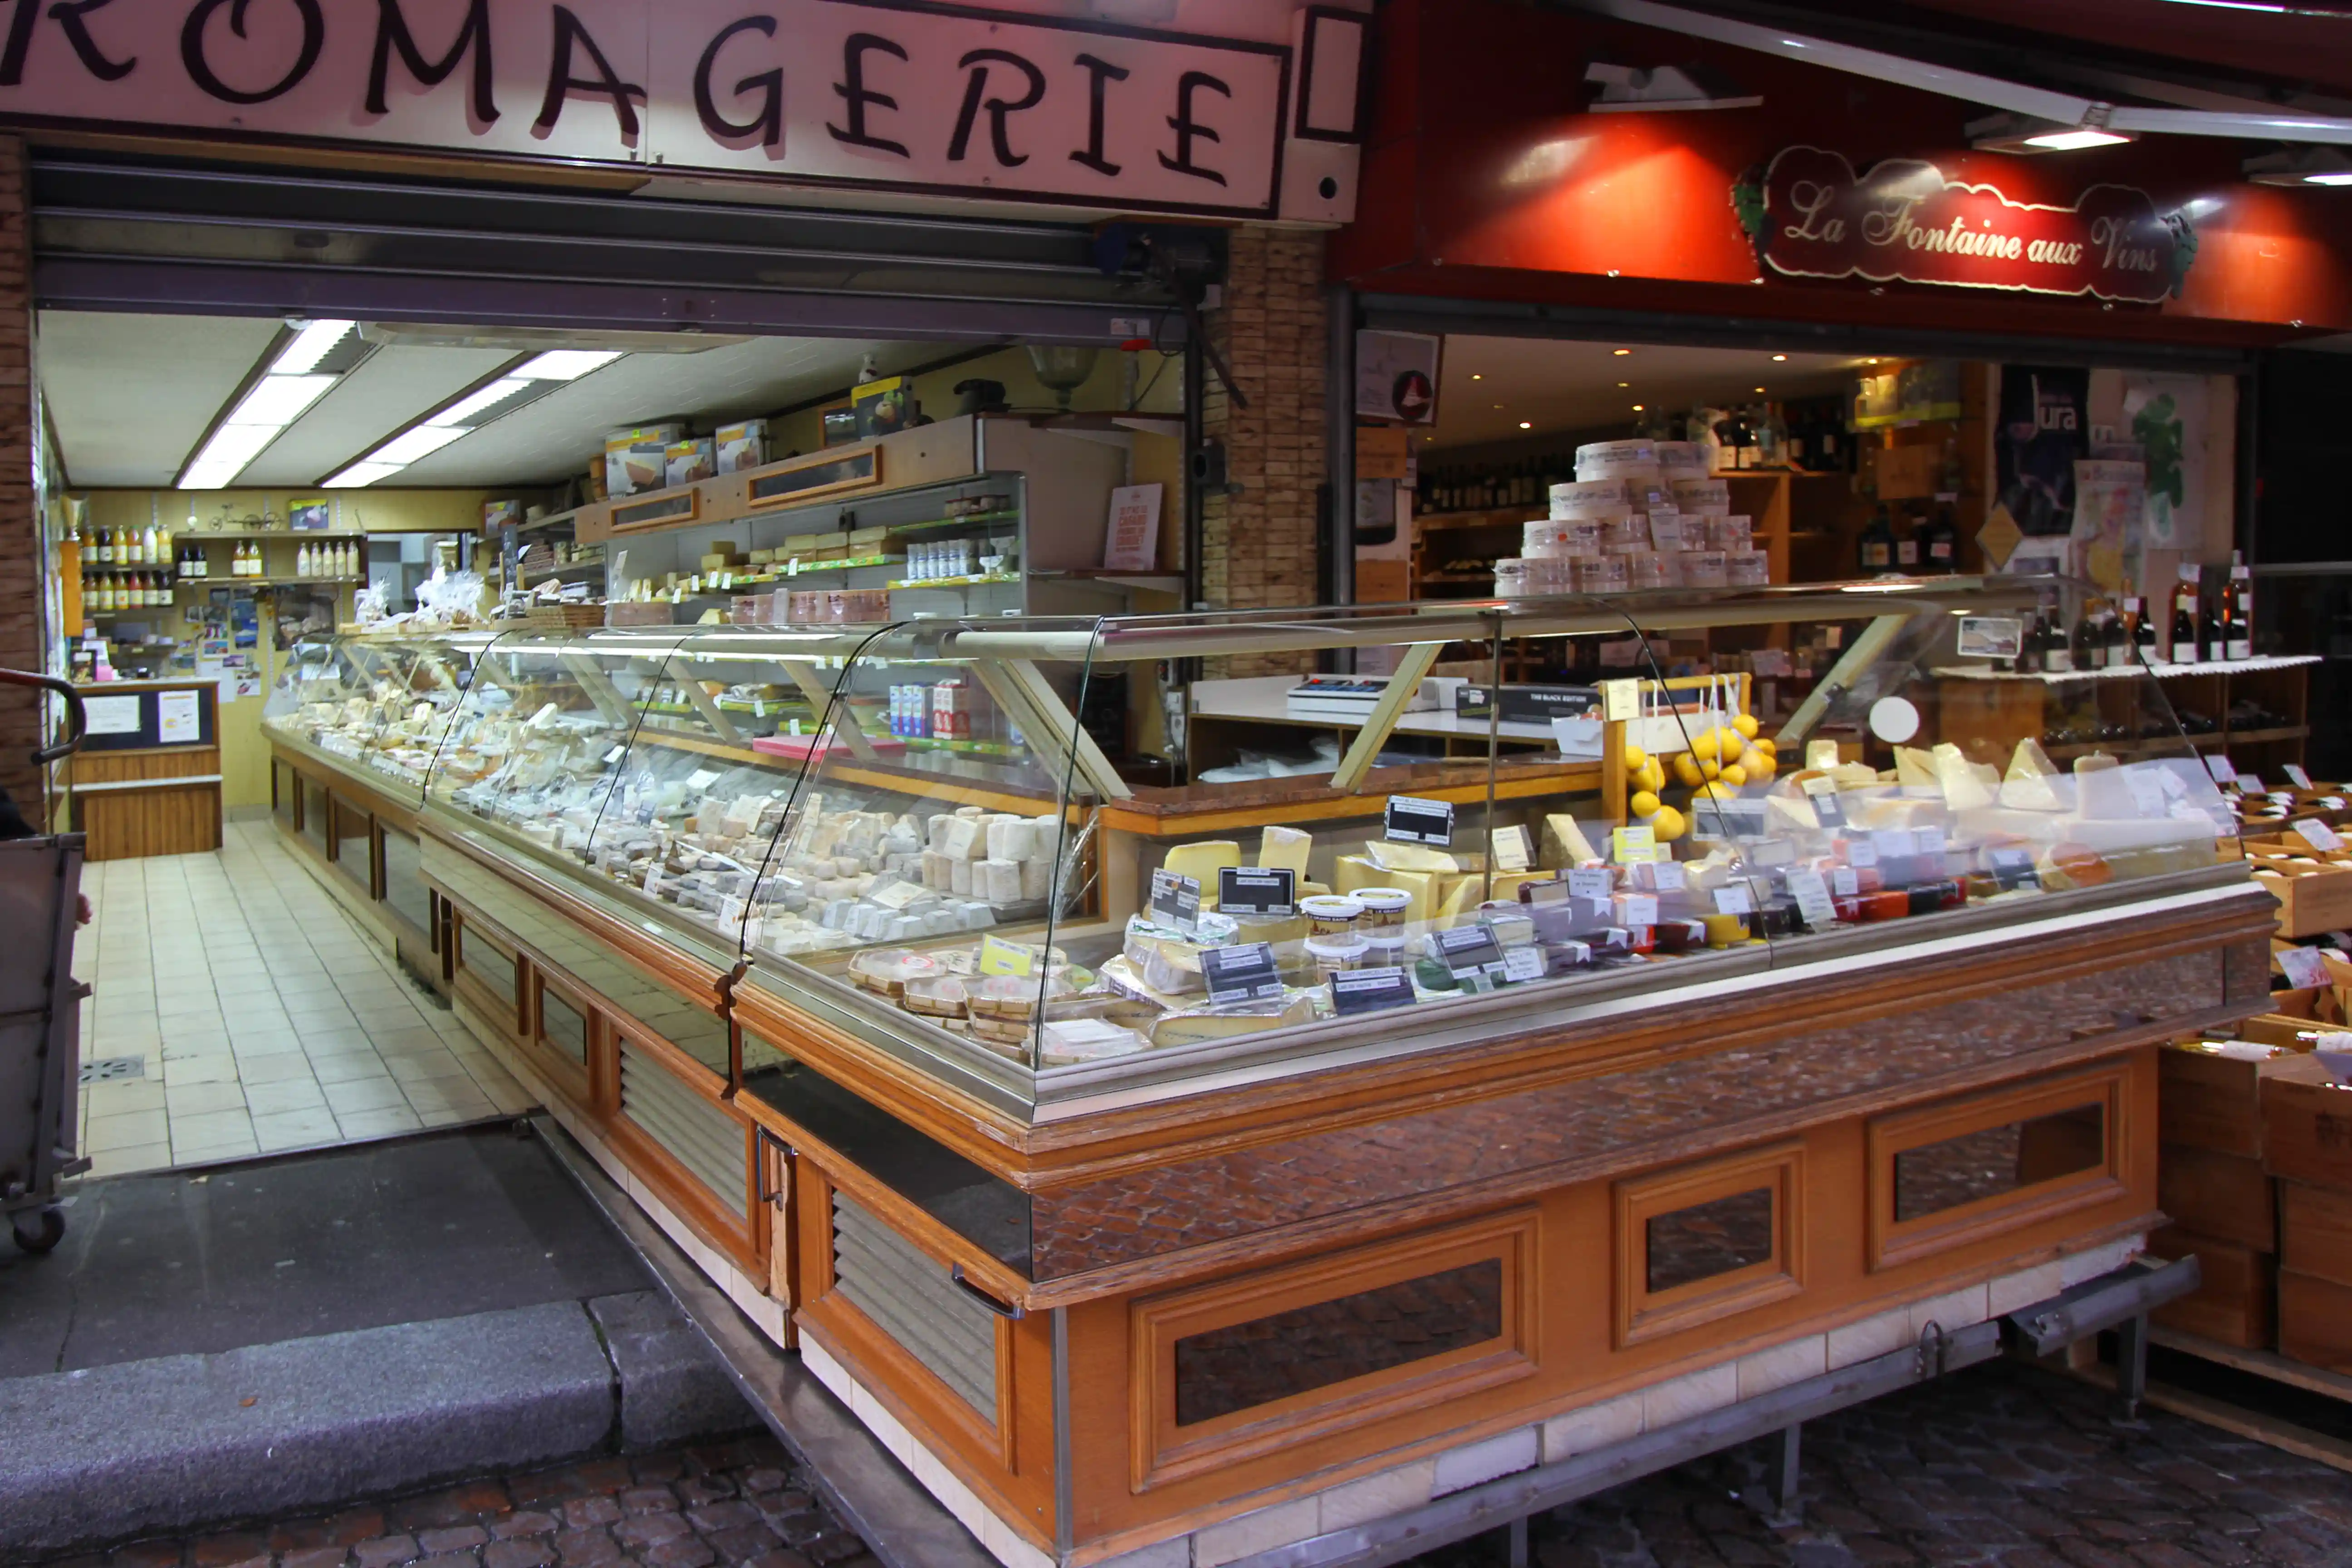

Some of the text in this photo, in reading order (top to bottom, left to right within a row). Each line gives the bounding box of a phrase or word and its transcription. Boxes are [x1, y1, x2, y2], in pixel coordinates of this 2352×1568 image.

[1784, 181, 2157, 271] La Fontaine aux Vins
[2028, 373, 2077, 441] Jura
